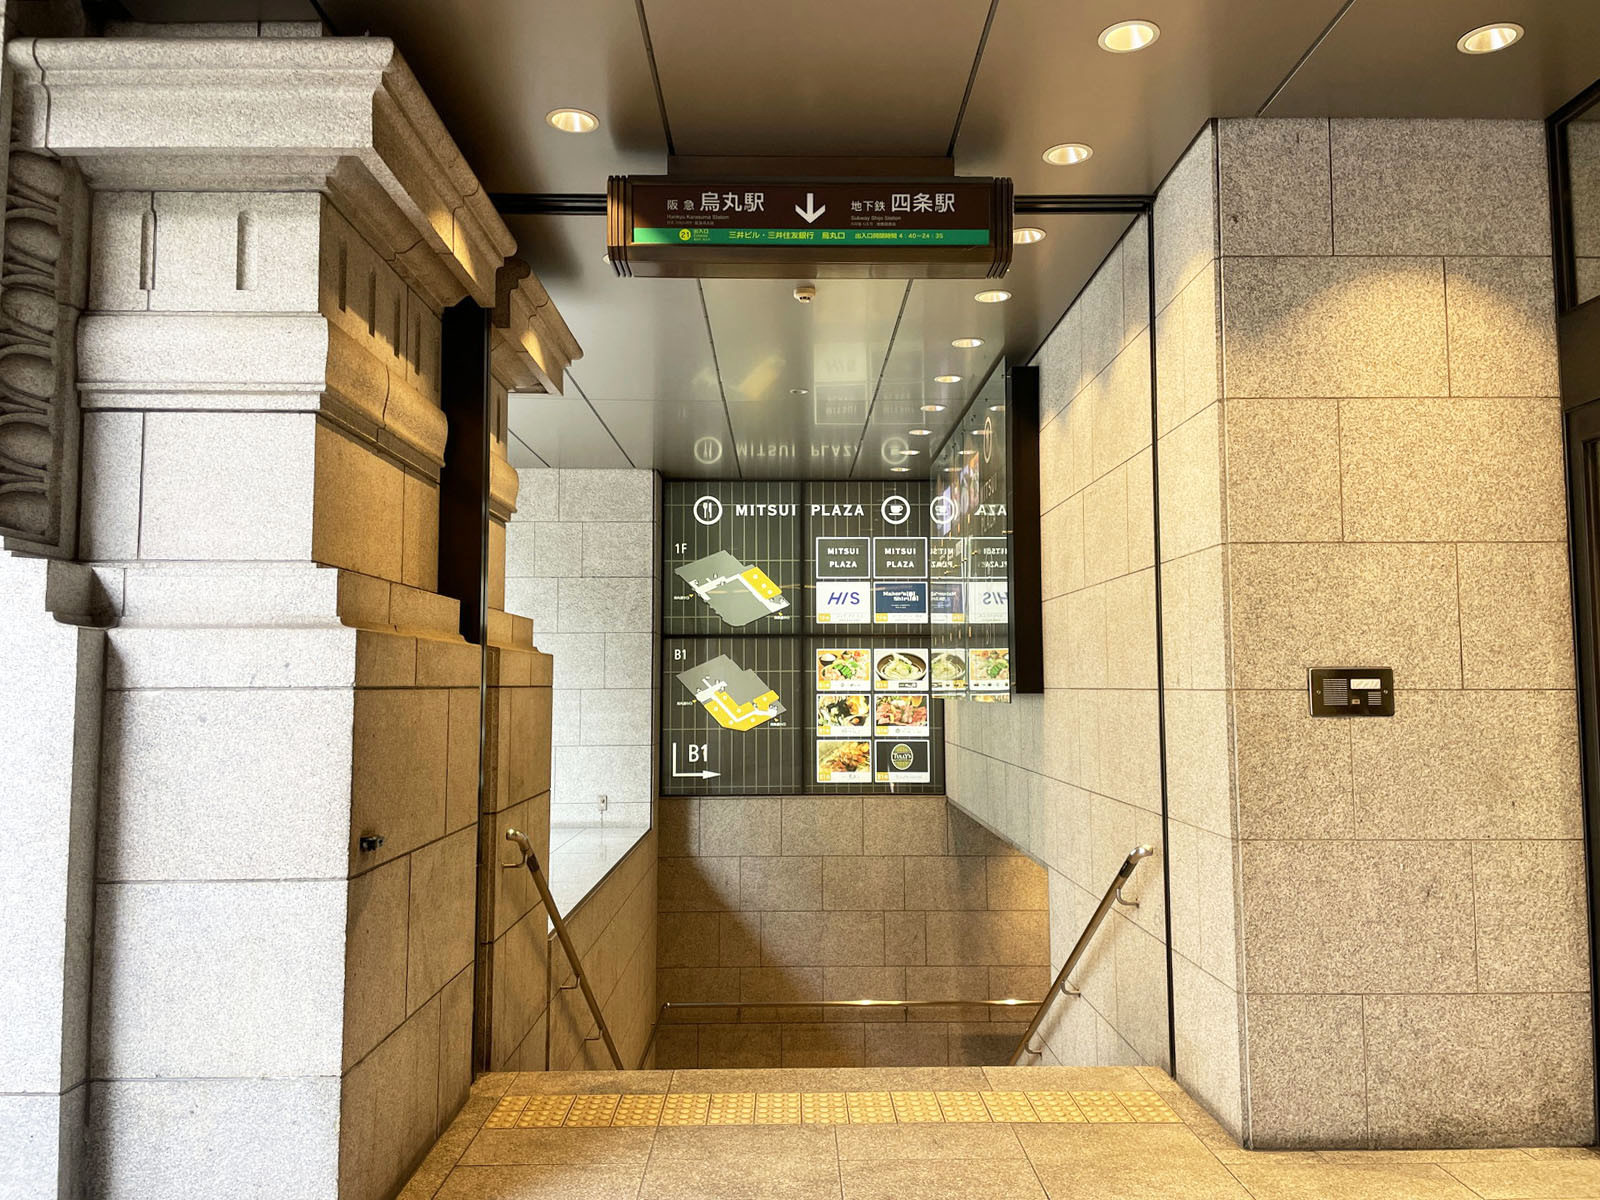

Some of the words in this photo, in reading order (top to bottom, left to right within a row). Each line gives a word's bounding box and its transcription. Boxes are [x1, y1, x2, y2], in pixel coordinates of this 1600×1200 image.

[700, 191, 764, 212] 烏丸駅
[851, 200, 886, 212] 地下鉄
[891, 193, 955, 213] 四条駅
[680, 231, 690, 239] 21
[735, 504, 796, 517] MITSUI
[811, 504, 865, 517] PLAZA
[674, 543, 688, 554] 1F
[827, 547, 859, 555] MITSUI
[884, 547, 916, 555] MITSUI
[829, 560, 858, 568] PLAZA
[886, 560, 915, 568] PLAZA
[674, 649, 687, 660] B1
[688, 744, 708, 762] B1
